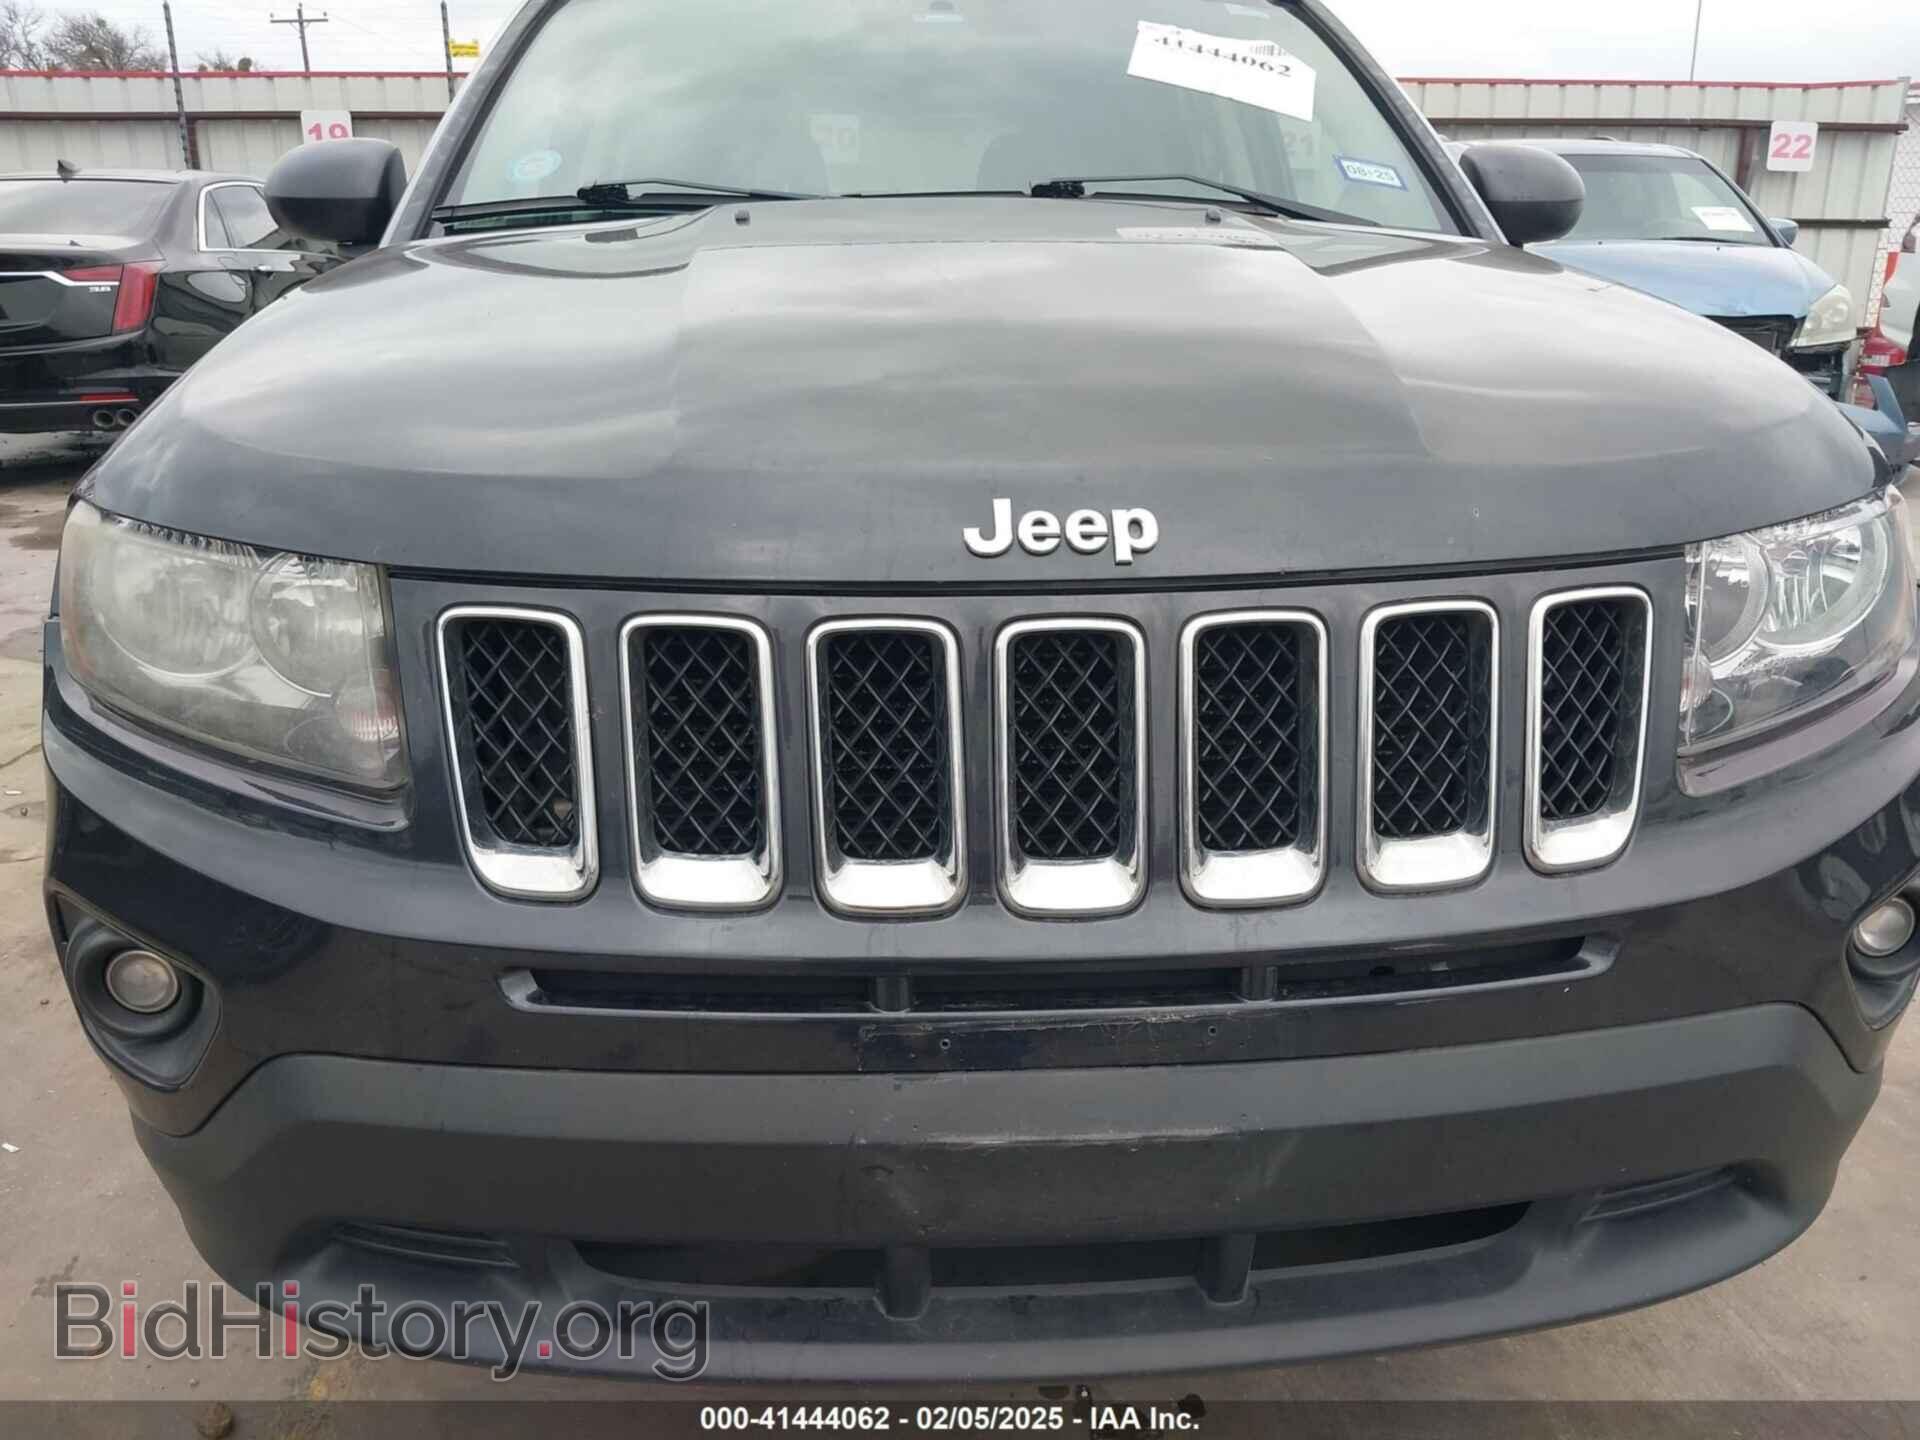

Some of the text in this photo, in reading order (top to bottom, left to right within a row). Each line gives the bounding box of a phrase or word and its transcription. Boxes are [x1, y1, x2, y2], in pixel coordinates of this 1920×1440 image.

[1153, 35, 1292, 78] 41444062
[1771, 133, 1811, 159] 22
[963, 498, 1159, 566] Jeep
